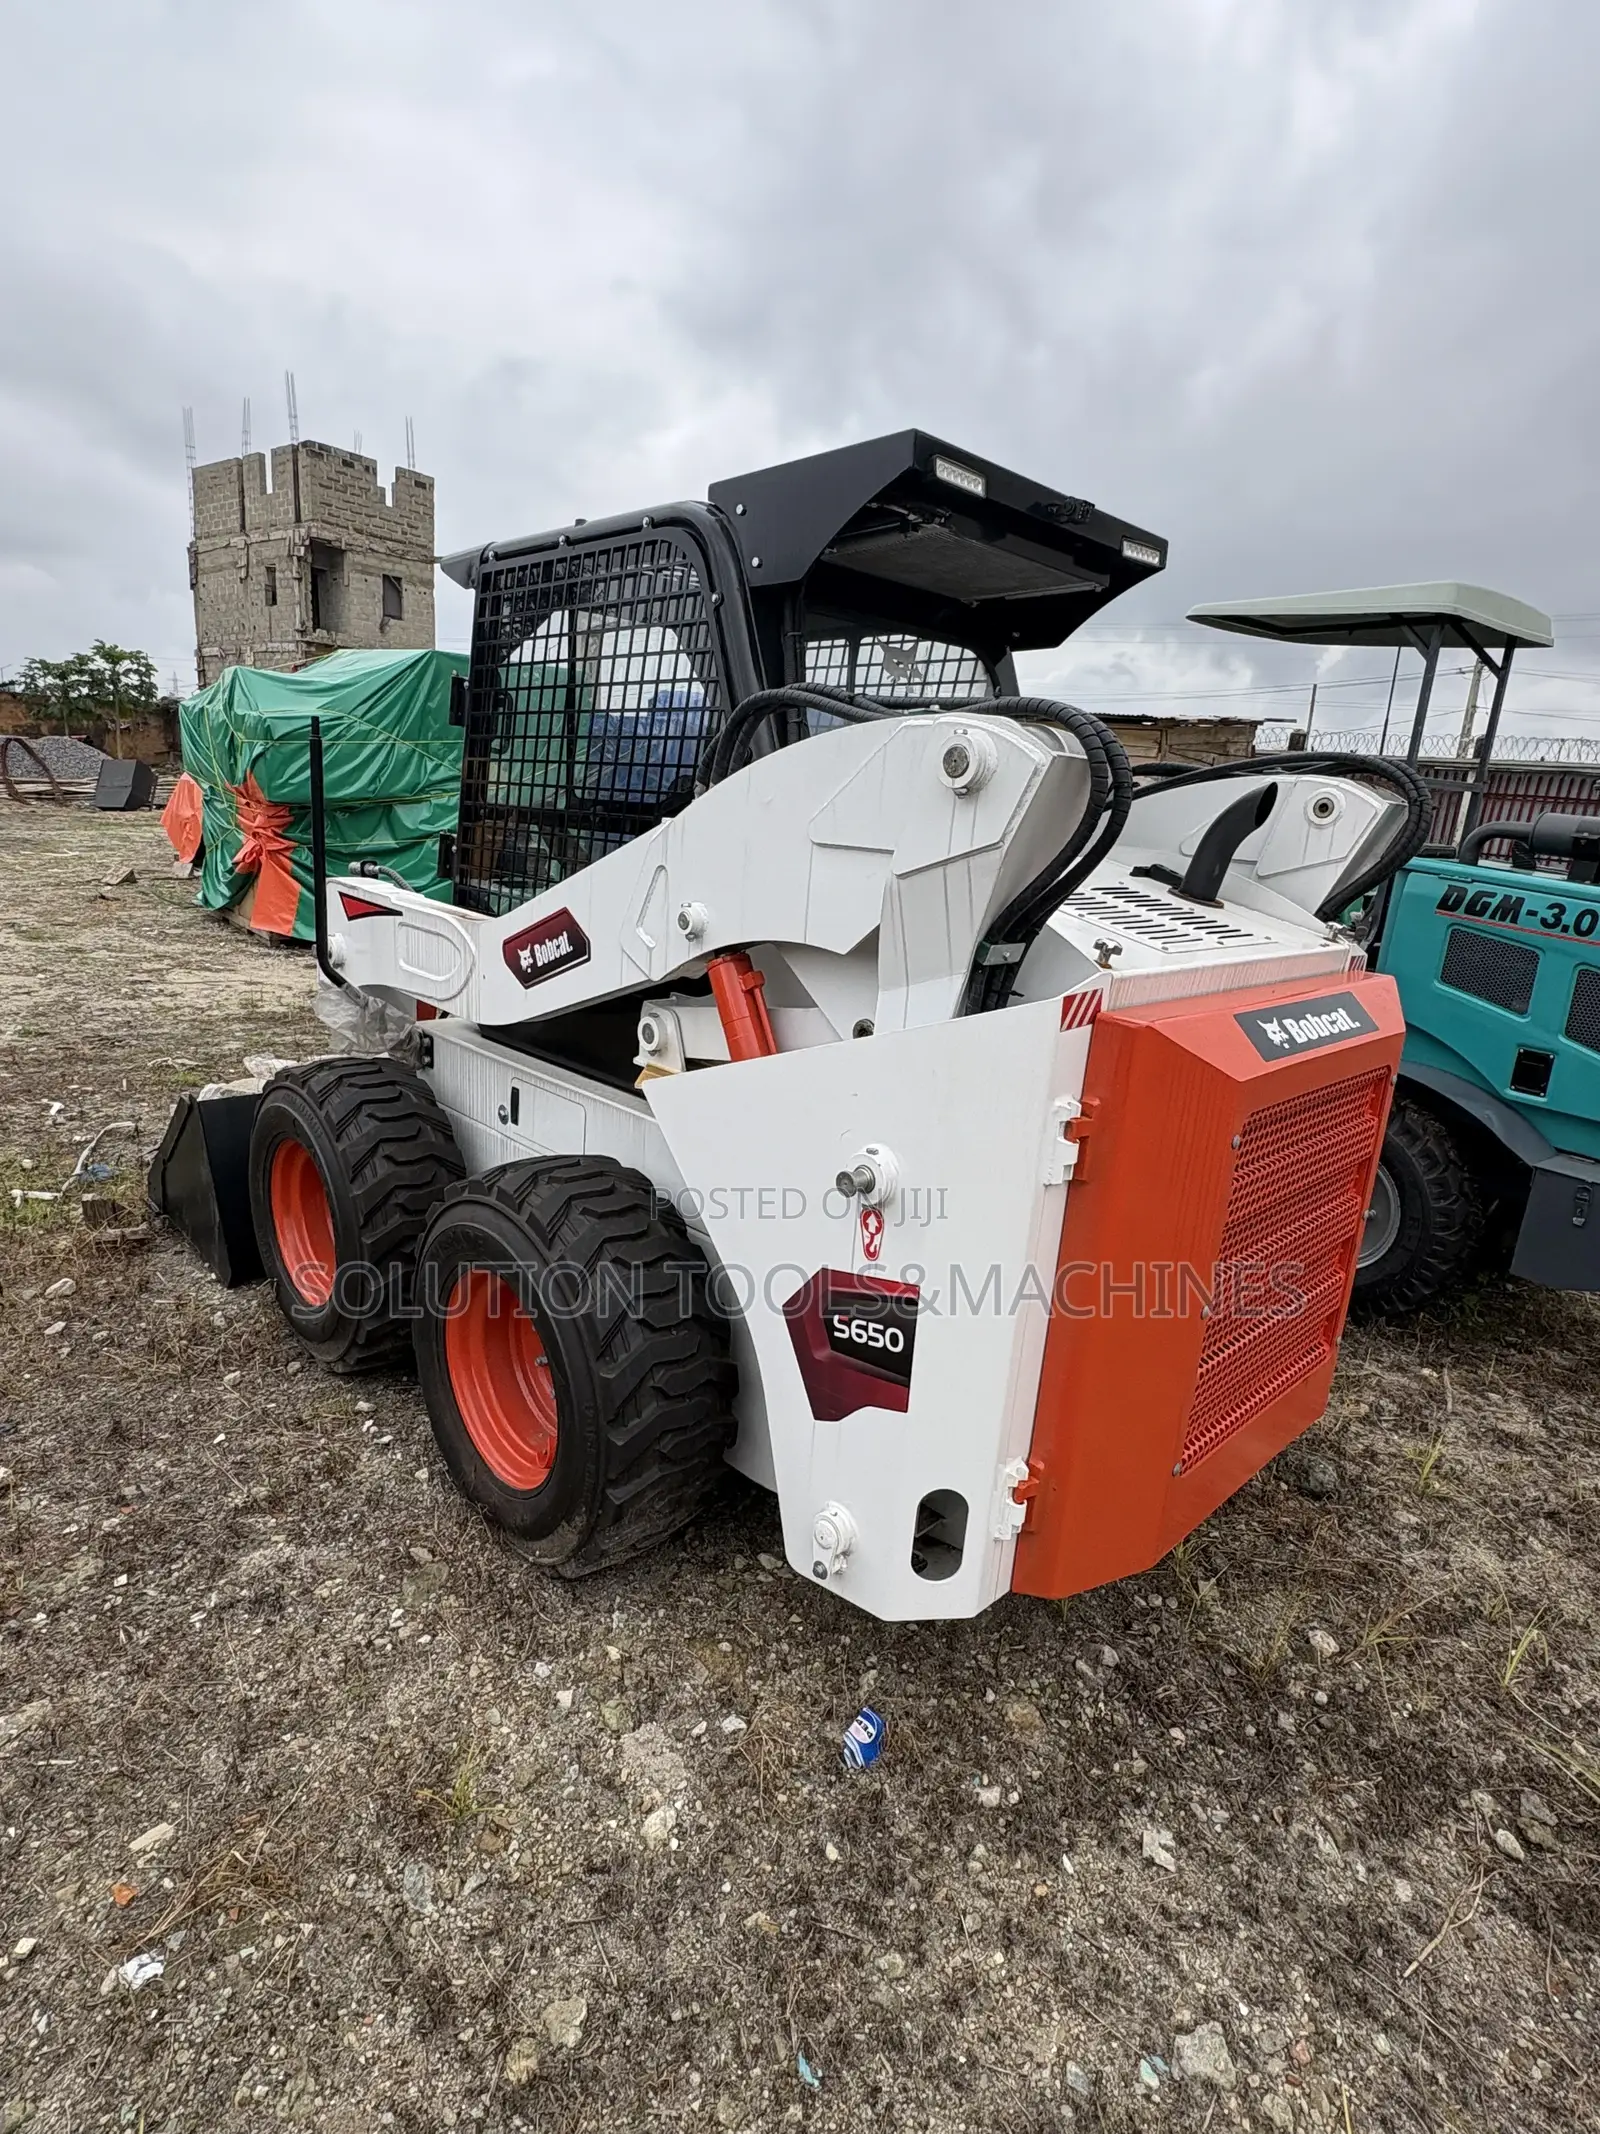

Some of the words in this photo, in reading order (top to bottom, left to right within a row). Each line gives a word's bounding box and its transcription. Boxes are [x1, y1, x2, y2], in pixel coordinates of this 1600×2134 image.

[1436, 884, 1599, 938] DGM-3.0
[833, 1314, 905, 1352] S650
[855, 1719, 873, 1739] PEP
